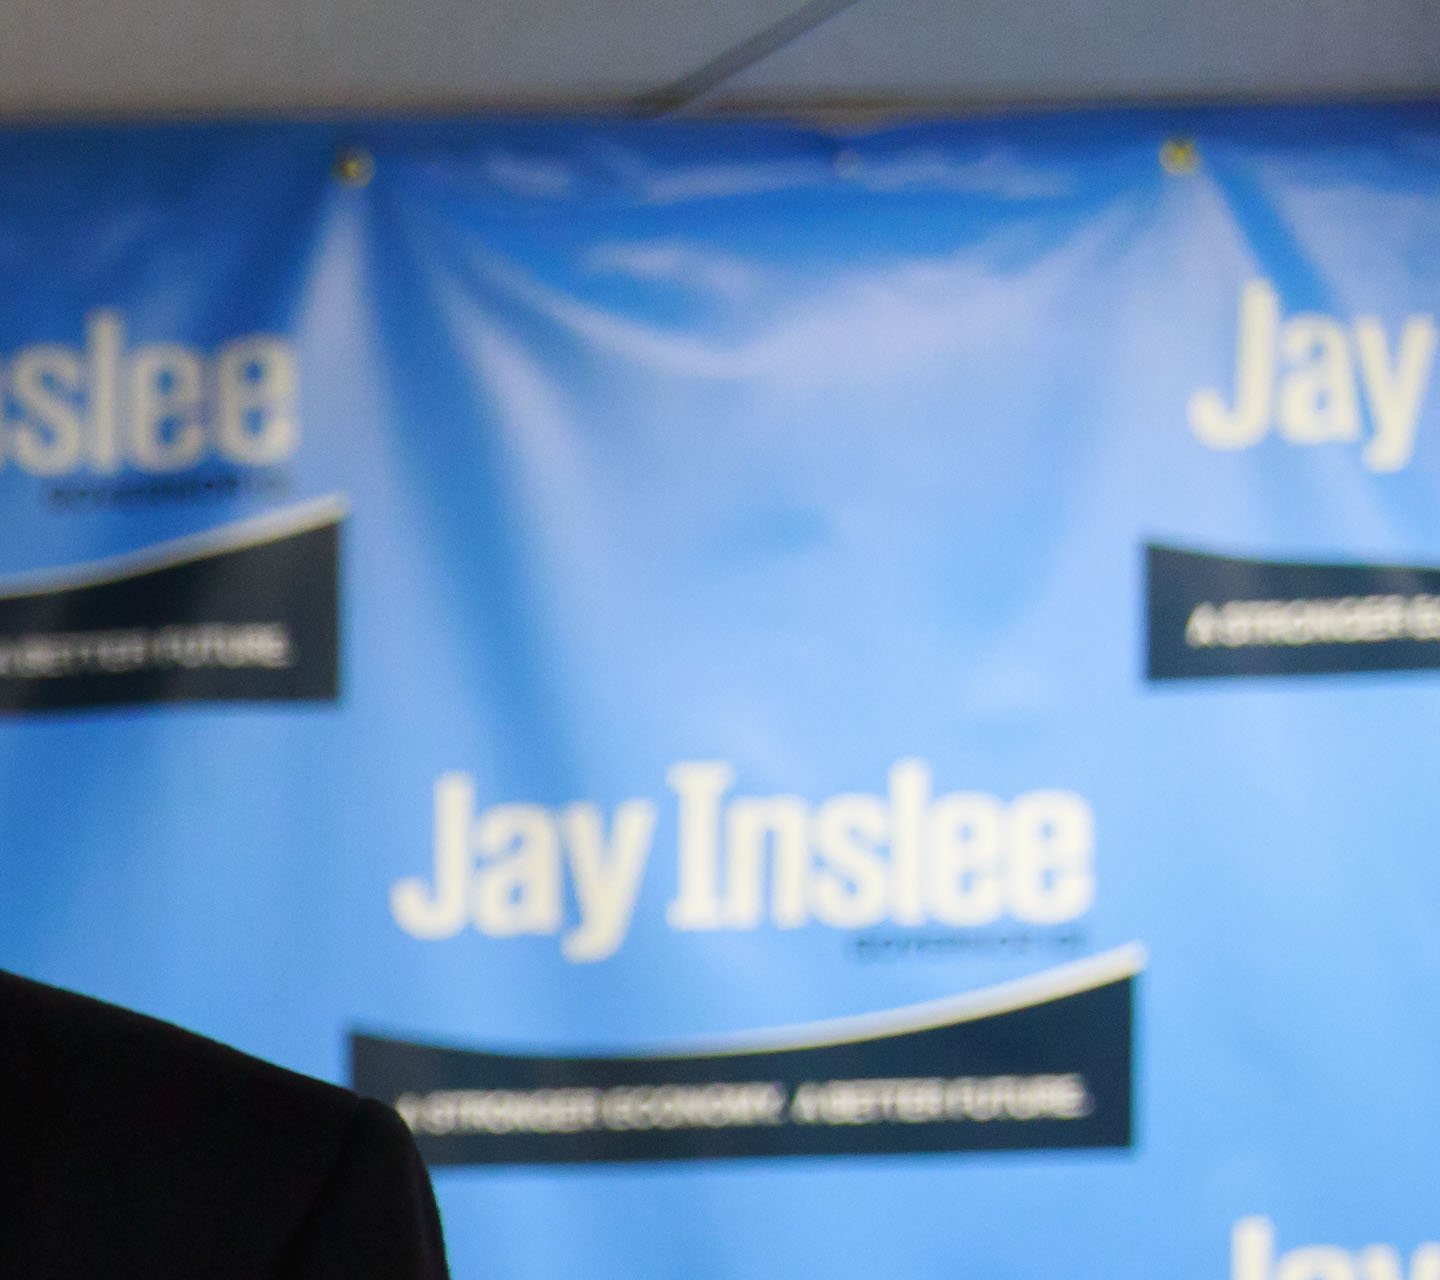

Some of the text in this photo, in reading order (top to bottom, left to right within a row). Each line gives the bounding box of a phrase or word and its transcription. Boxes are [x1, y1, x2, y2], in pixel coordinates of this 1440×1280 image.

[1187, 278, 1437, 473] Jay
[390, 759, 1096, 963] Jay Inslee
